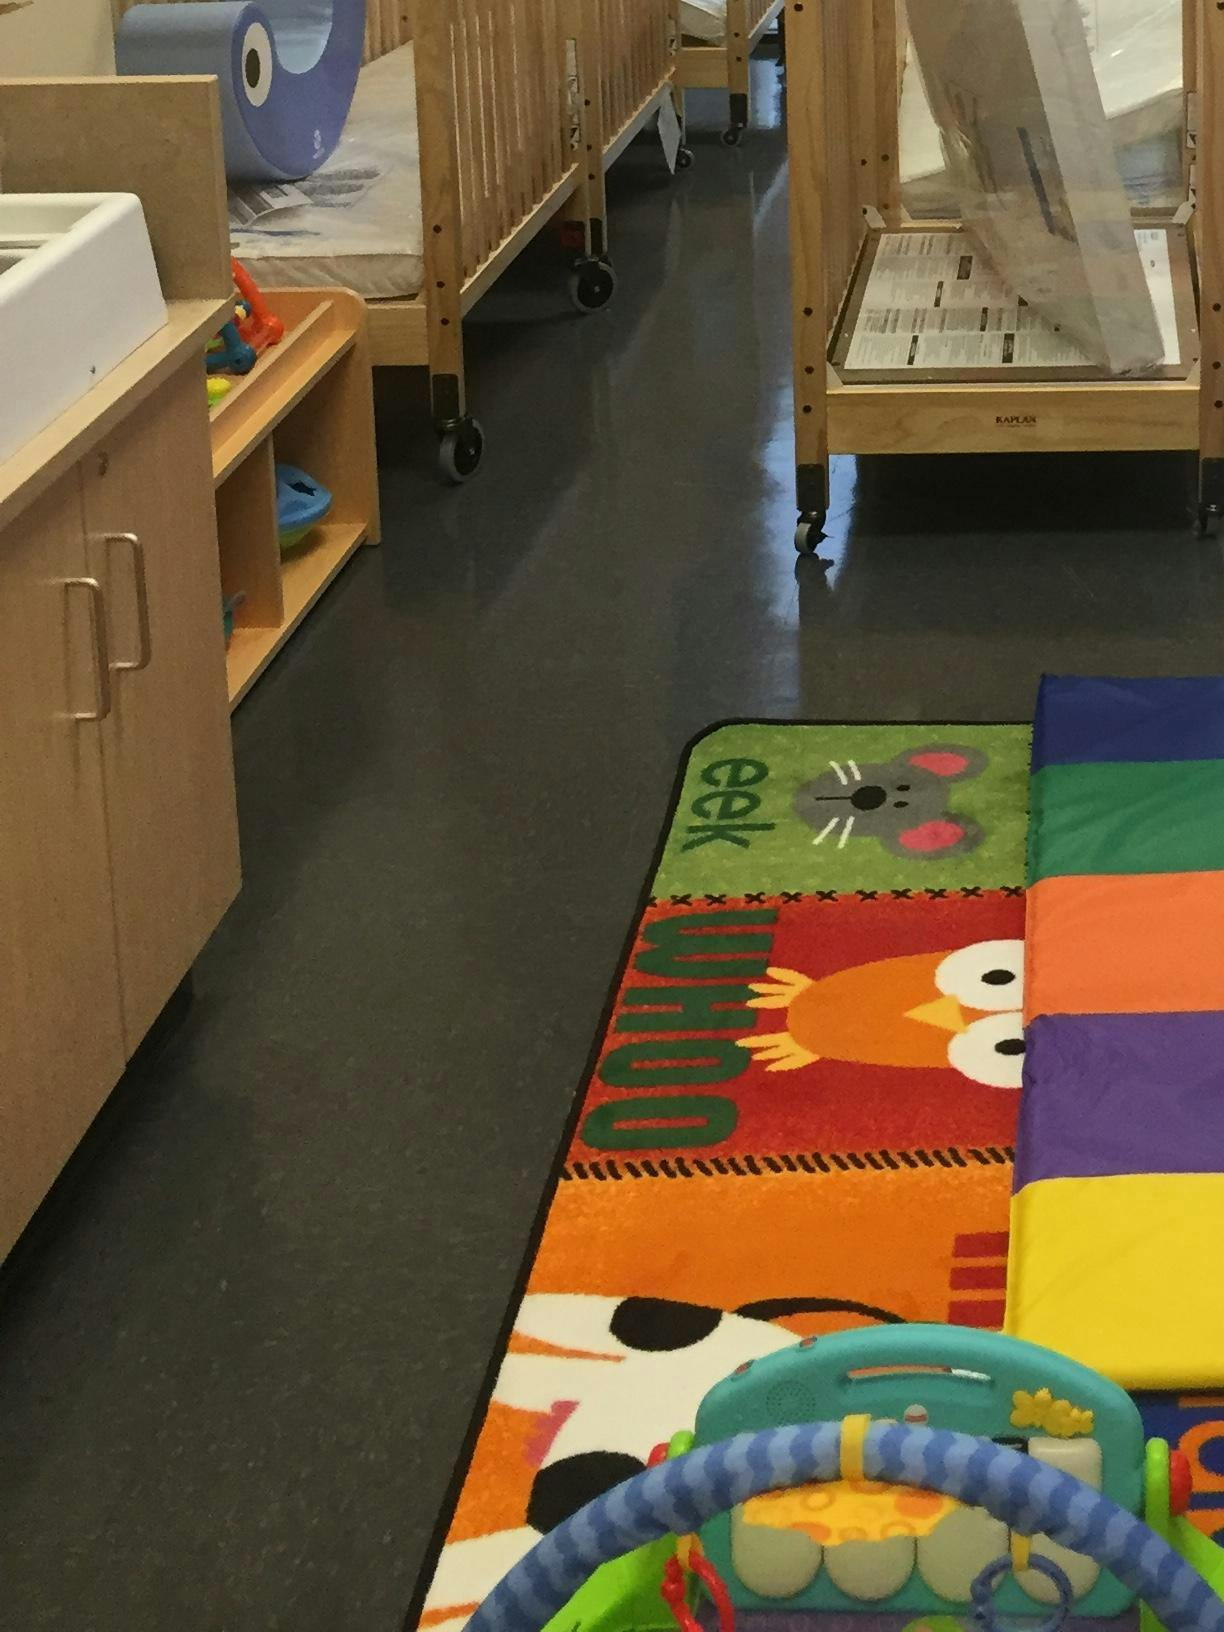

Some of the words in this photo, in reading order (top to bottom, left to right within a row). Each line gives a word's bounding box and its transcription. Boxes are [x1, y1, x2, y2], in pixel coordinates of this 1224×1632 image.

[995, 415, 1037, 424] KAPLAN
[680, 757, 776, 853] eek
[580, 908, 779, 1151] WHOO
